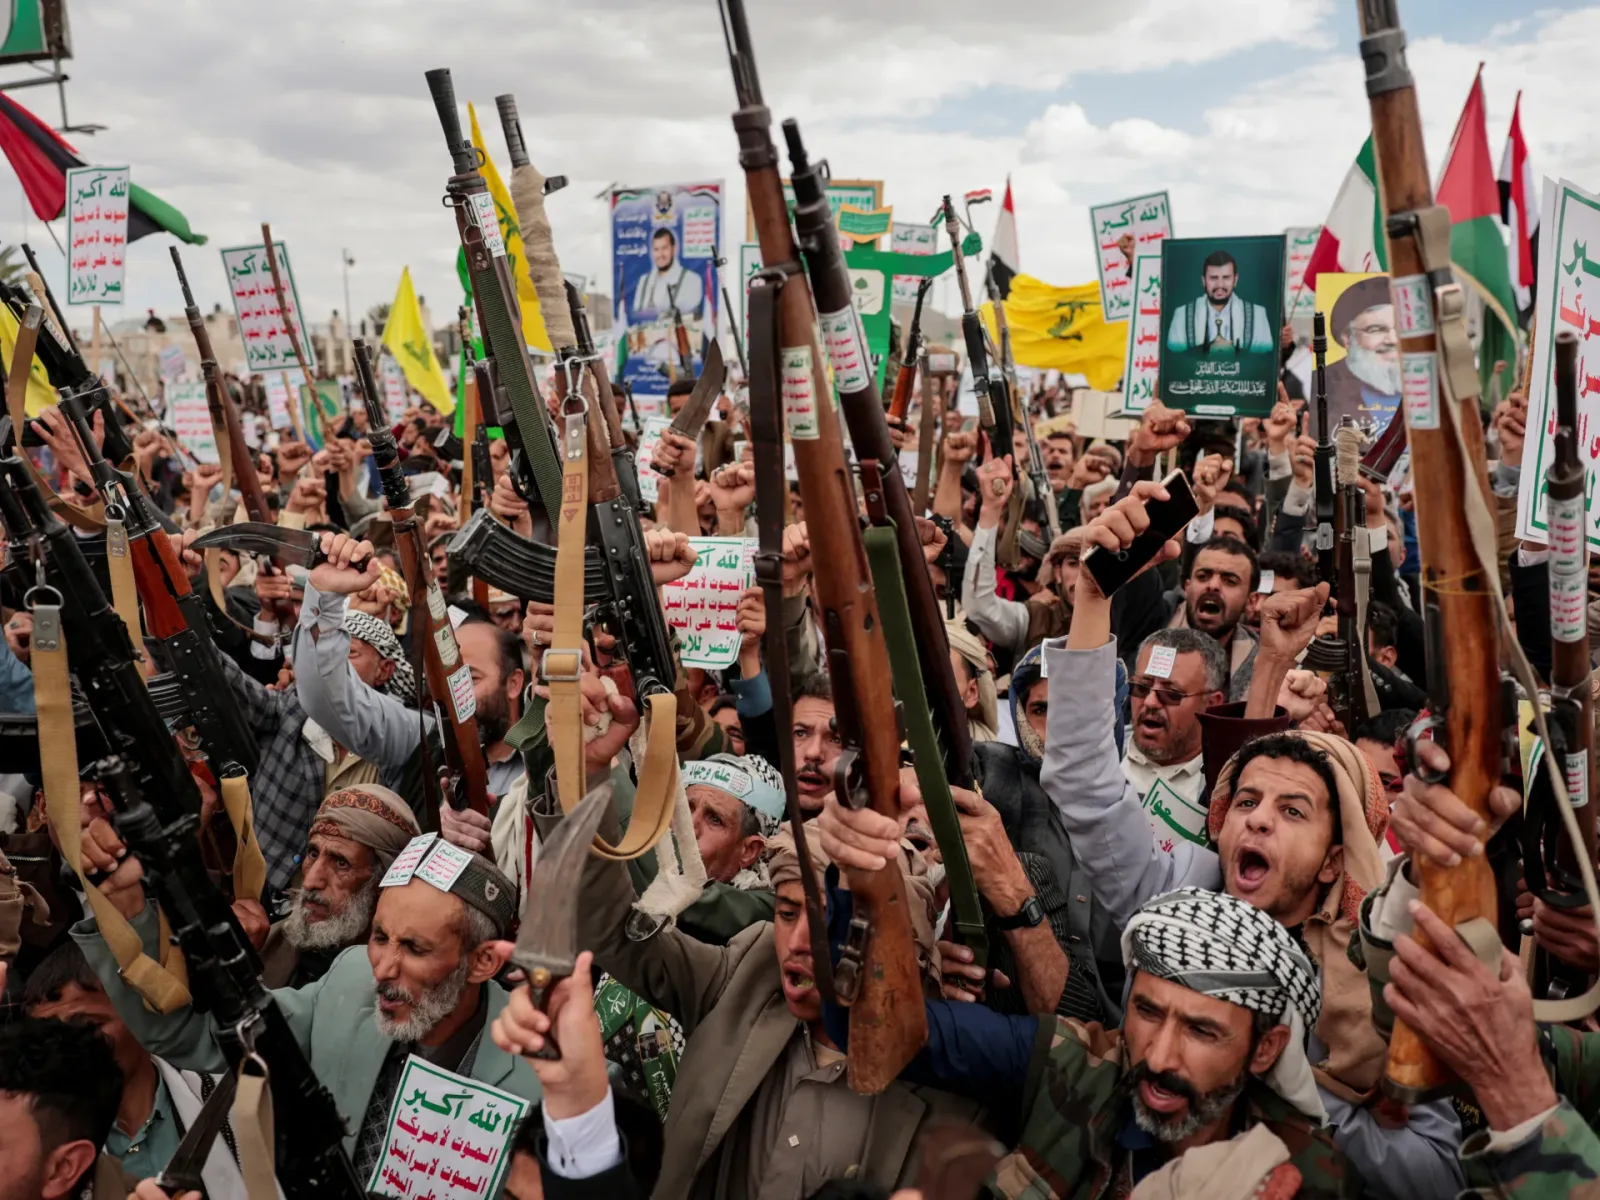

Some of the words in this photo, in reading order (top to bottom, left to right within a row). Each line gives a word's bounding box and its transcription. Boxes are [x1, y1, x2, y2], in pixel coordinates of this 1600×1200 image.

[74, 173, 107, 206] أكبر
[1100, 204, 1136, 235] أكبر
[1140, 201, 1166, 221] الله
[232, 251, 256, 282] أكبر
[1195, 361, 1216, 377] القائد
[1215, 361, 1240, 376] السيد
[709, 578, 744, 593] الموت
[695, 617, 711, 632] على
[703, 636, 736, 657] النصر
[403, 1088, 474, 1119] أكبر
[396, 1109, 450, 1147] لأمريكا
[468, 1101, 513, 1136] الله
[390, 1139, 440, 1180] لإسرائيل
[451, 1137, 499, 1165] الموت
[440, 1166, 487, 1195] الموت
